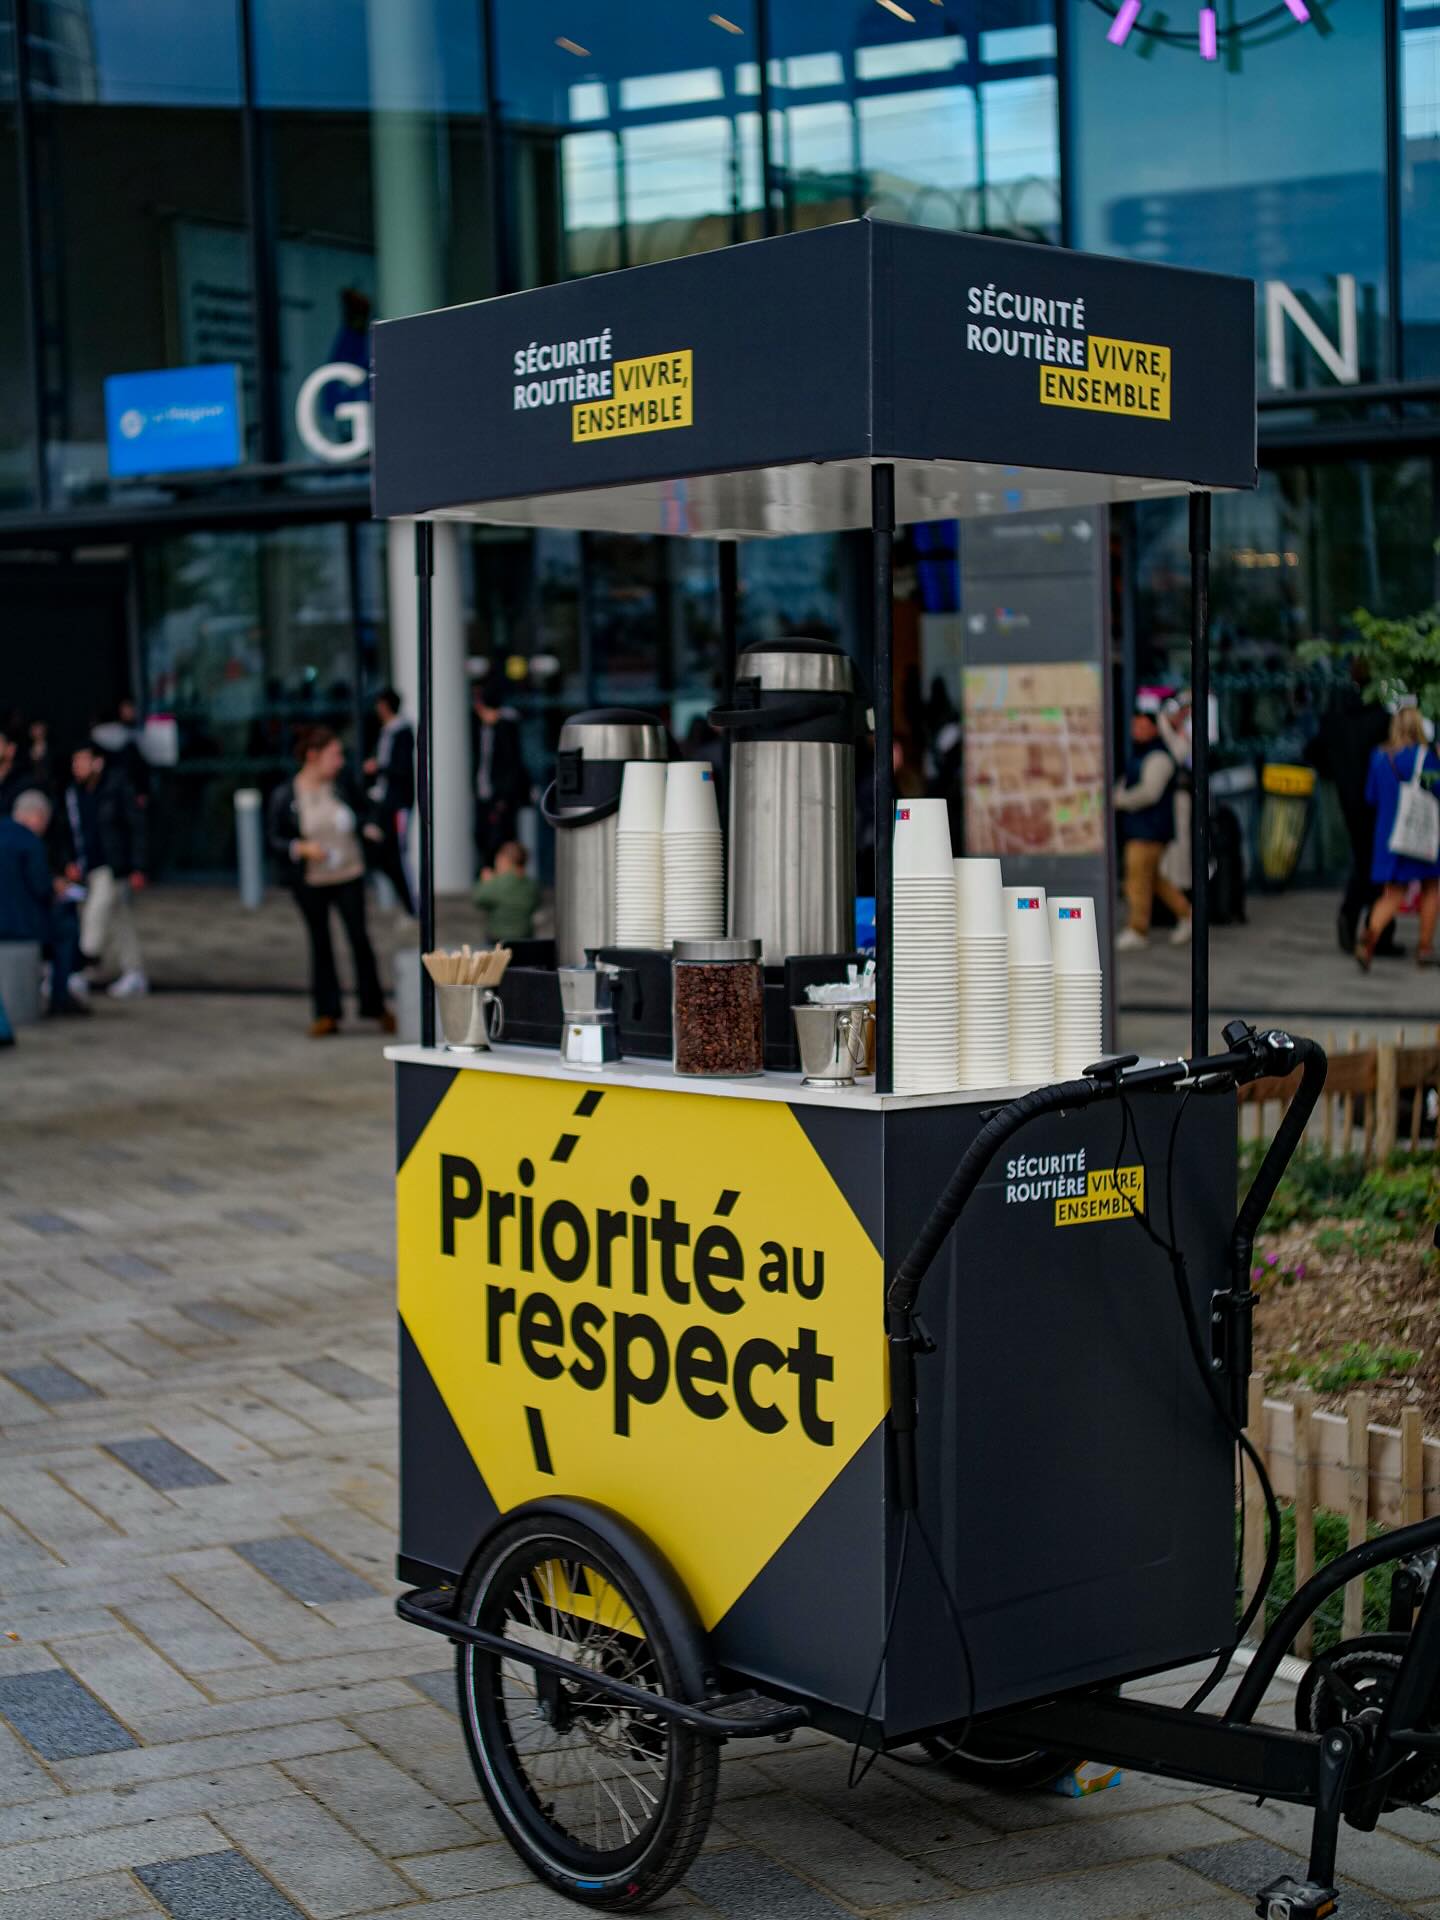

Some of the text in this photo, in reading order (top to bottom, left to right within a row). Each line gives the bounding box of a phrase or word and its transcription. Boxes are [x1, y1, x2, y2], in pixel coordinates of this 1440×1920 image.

[967, 283, 1086, 330] SÉCURITÉ
[513, 327, 612, 376] SÉCURITÉ
[966, 323, 1167, 383] ROUTIÈRE VIVRE,
[513, 358, 688, 410] ROUTIÈRE VIVRE,
[1045, 373, 1160, 411] ENSEMBLE
[577, 395, 682, 434] ENSEMBLE
[1006, 1147, 1086, 1179] SÉCURITÉ
[1006, 1171, 1142, 1204] ROUTIÈRE VIVRE,
[440, 1152, 825, 1315] Priorité au
[485, 1284, 835, 1447] respect
